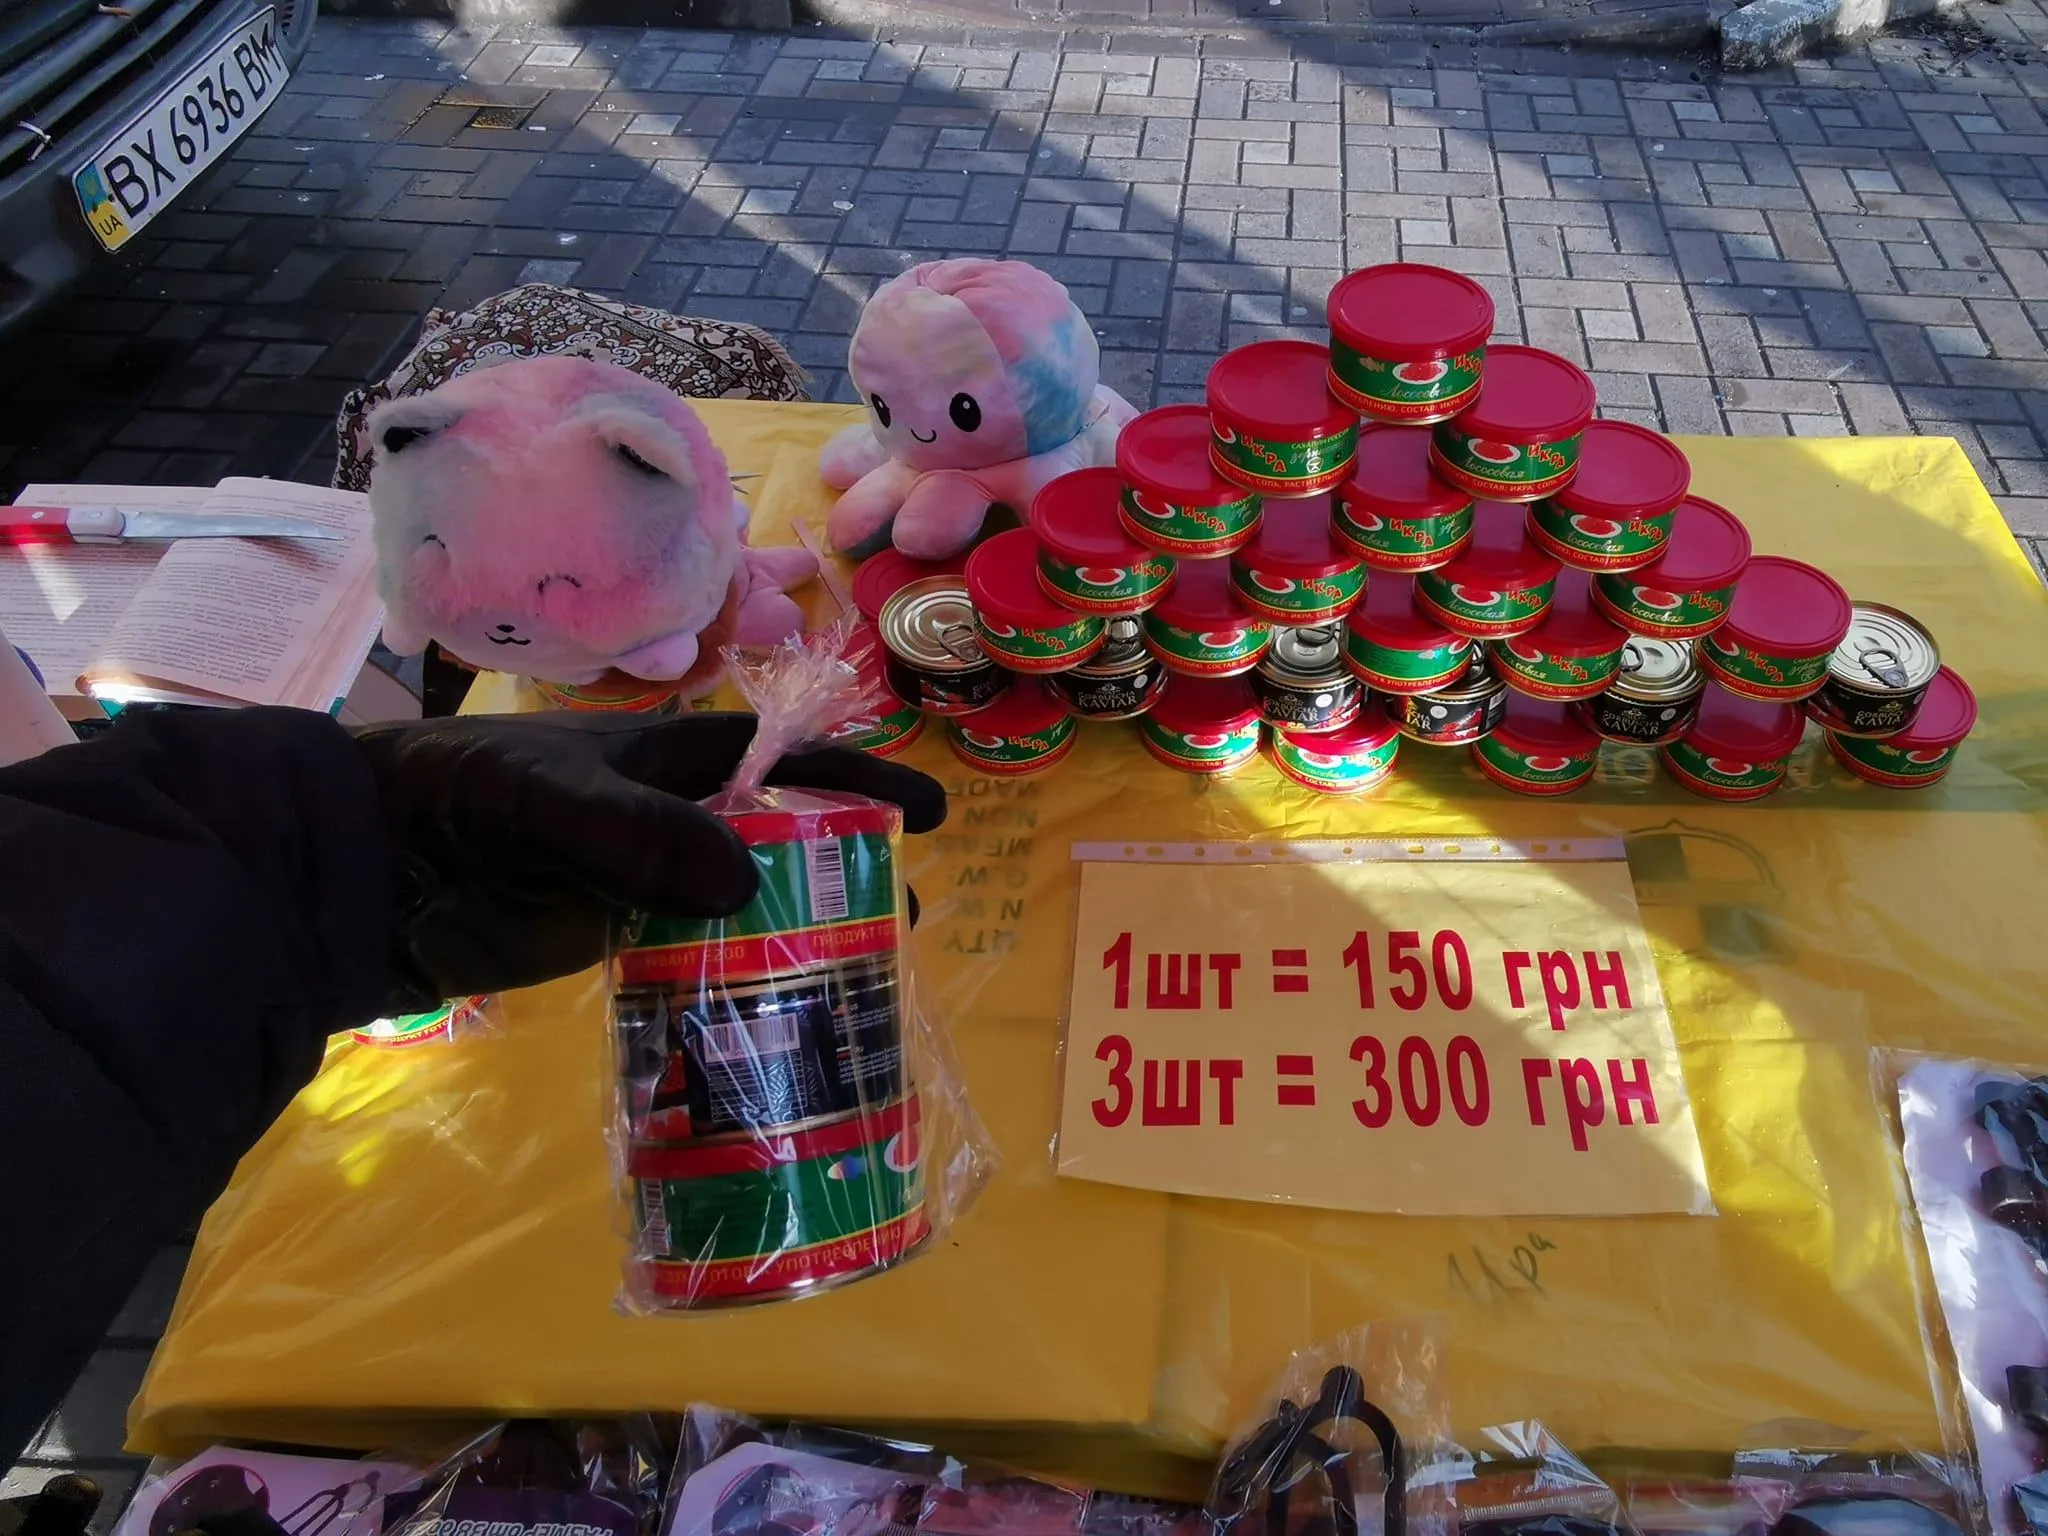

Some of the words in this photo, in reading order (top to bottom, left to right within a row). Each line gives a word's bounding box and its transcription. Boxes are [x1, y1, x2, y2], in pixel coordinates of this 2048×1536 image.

[104, 128, 176, 218] BX
[169, 62, 244, 165] 6936
[233, 22, 281, 101] BM
[99, 214, 123, 237] UA
[1240, 434, 1287, 473] ИКРА
[1527, 443, 1565, 469] ИКРА
[1181, 505, 1227, 533] ИКРА
[1390, 518, 1434, 547] ИКРА
[1302, 579, 1343, 600] ИКРА
[1507, 590, 1542, 609] ИКРА
[1022, 628, 1066, 651] ИКРА
[1549, 654, 1589, 681] ИКРА
[1745, 649, 1784, 682] ИКРА
[1079, 696, 1137, 708] KAVIAR
[1854, 715, 1901, 725] KAVIA
[812, 927, 877, 948] ПРОДУКТ
[1102, 931, 1242, 1010] 1шт
[1272, 949, 1309, 993] =
[1342, 929, 1474, 1011] 150
[1501, 950, 1632, 1031] грн
[423, 1019, 450, 1037] ГОТО
[1091, 1034, 1243, 1127] 3шт
[1277, 1055, 1316, 1106] =
[1348, 1035, 1490, 1128] 300
[1521, 1057, 1659, 1151] грн
